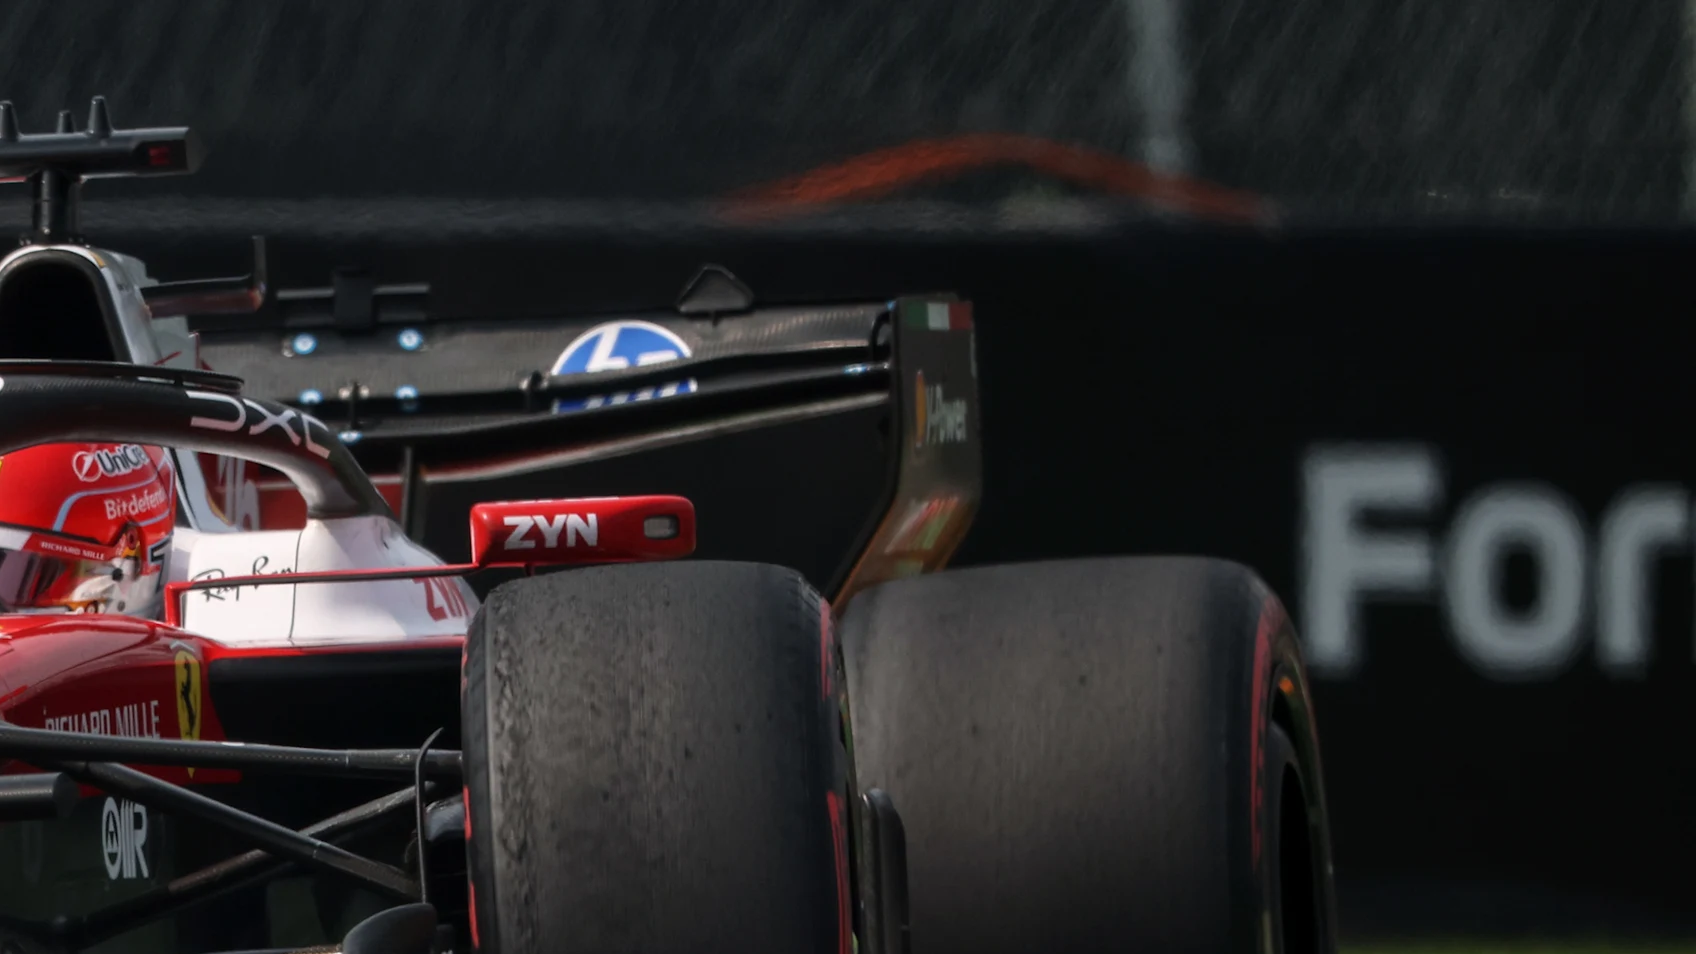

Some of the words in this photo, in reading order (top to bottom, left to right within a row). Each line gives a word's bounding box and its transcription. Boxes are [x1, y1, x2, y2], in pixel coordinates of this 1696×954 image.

[185, 390, 330, 459] DXC
[97, 445, 148, 475] UniCre
[504, 513, 598, 549] ZYN
[191, 556, 294, 603] RayBan
[1302, 442, 1696, 678] For
[115, 700, 161, 739] MILLE
